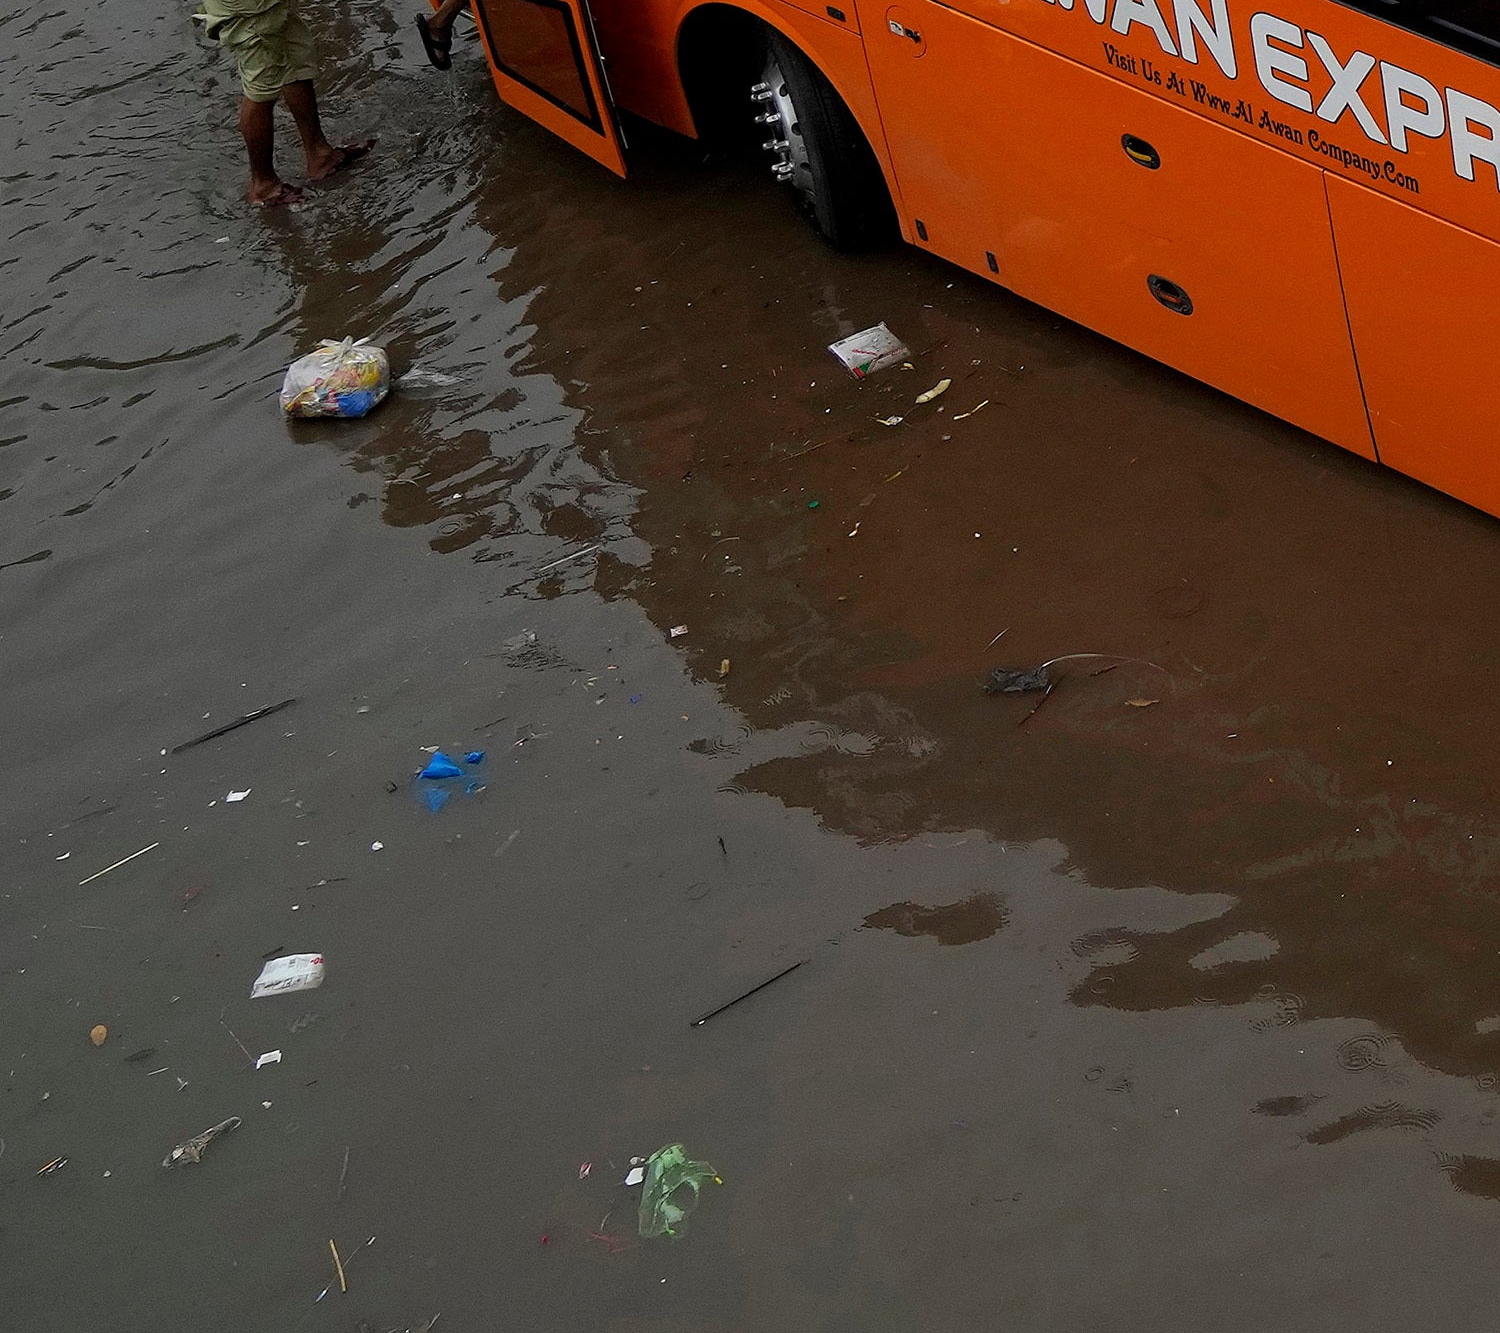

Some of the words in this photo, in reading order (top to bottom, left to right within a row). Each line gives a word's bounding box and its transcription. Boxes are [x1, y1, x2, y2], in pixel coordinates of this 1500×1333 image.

[1102, 42, 1139, 76] Visit
[1142, 59, 1163, 87] Us
[1166, 69, 1187, 98] At
[1258, 106, 1305, 147] Awan
[1308, 128, 1421, 195] Company.Com
